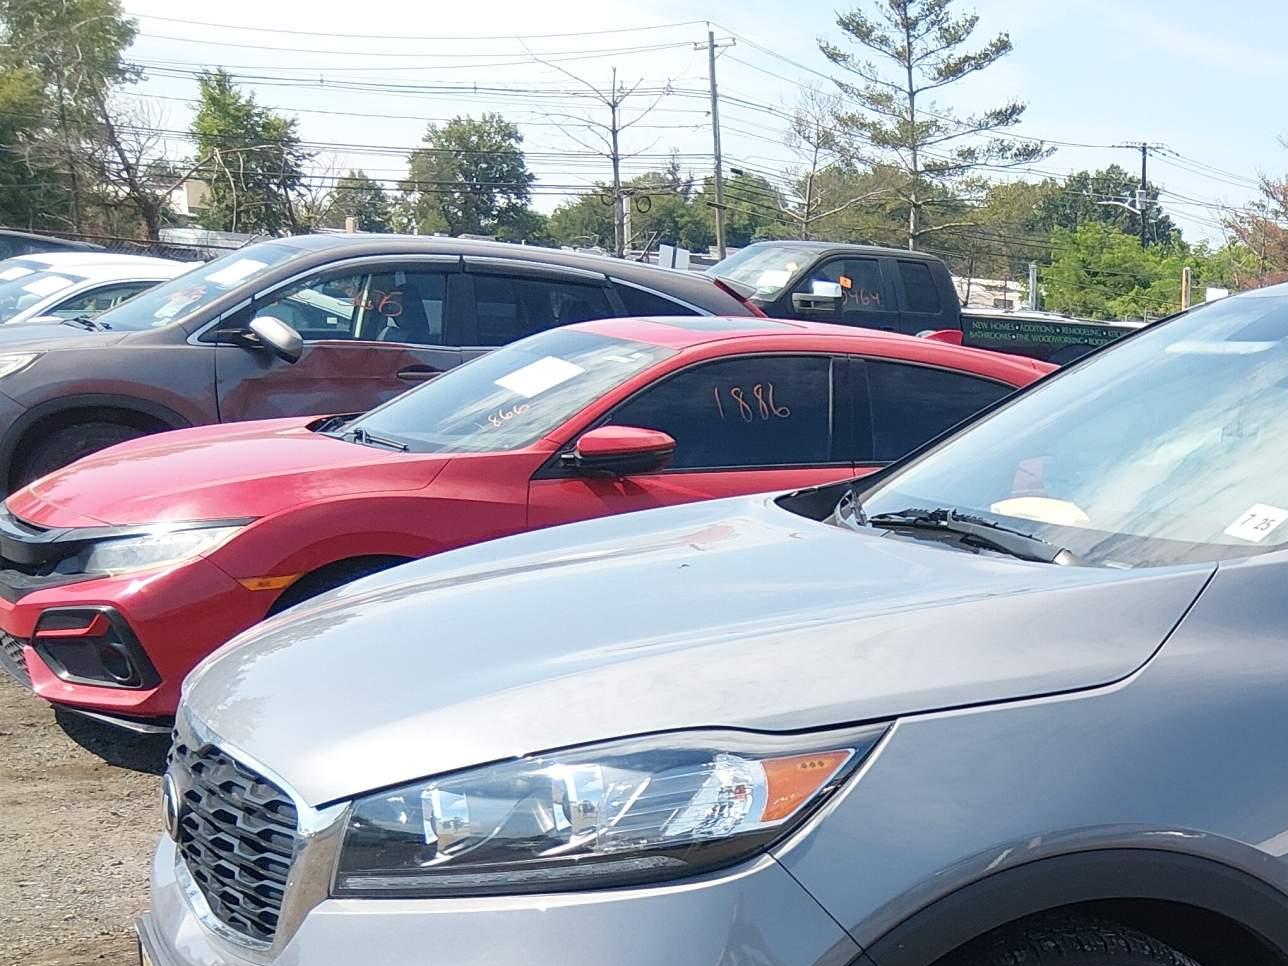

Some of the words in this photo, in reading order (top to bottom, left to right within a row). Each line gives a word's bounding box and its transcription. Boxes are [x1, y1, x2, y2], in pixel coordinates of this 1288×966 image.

[972, 322, 989, 330] NEW
[990, 323, 1015, 331] HOMES
[1020, 324, 1055, 334] ADDITIONS
[1061, 327, 1102, 337] REMODELING
[714, 382, 791, 423] 1886
[1240, 513, 1257, 525] 7
[1252, 517, 1276, 531] 25
